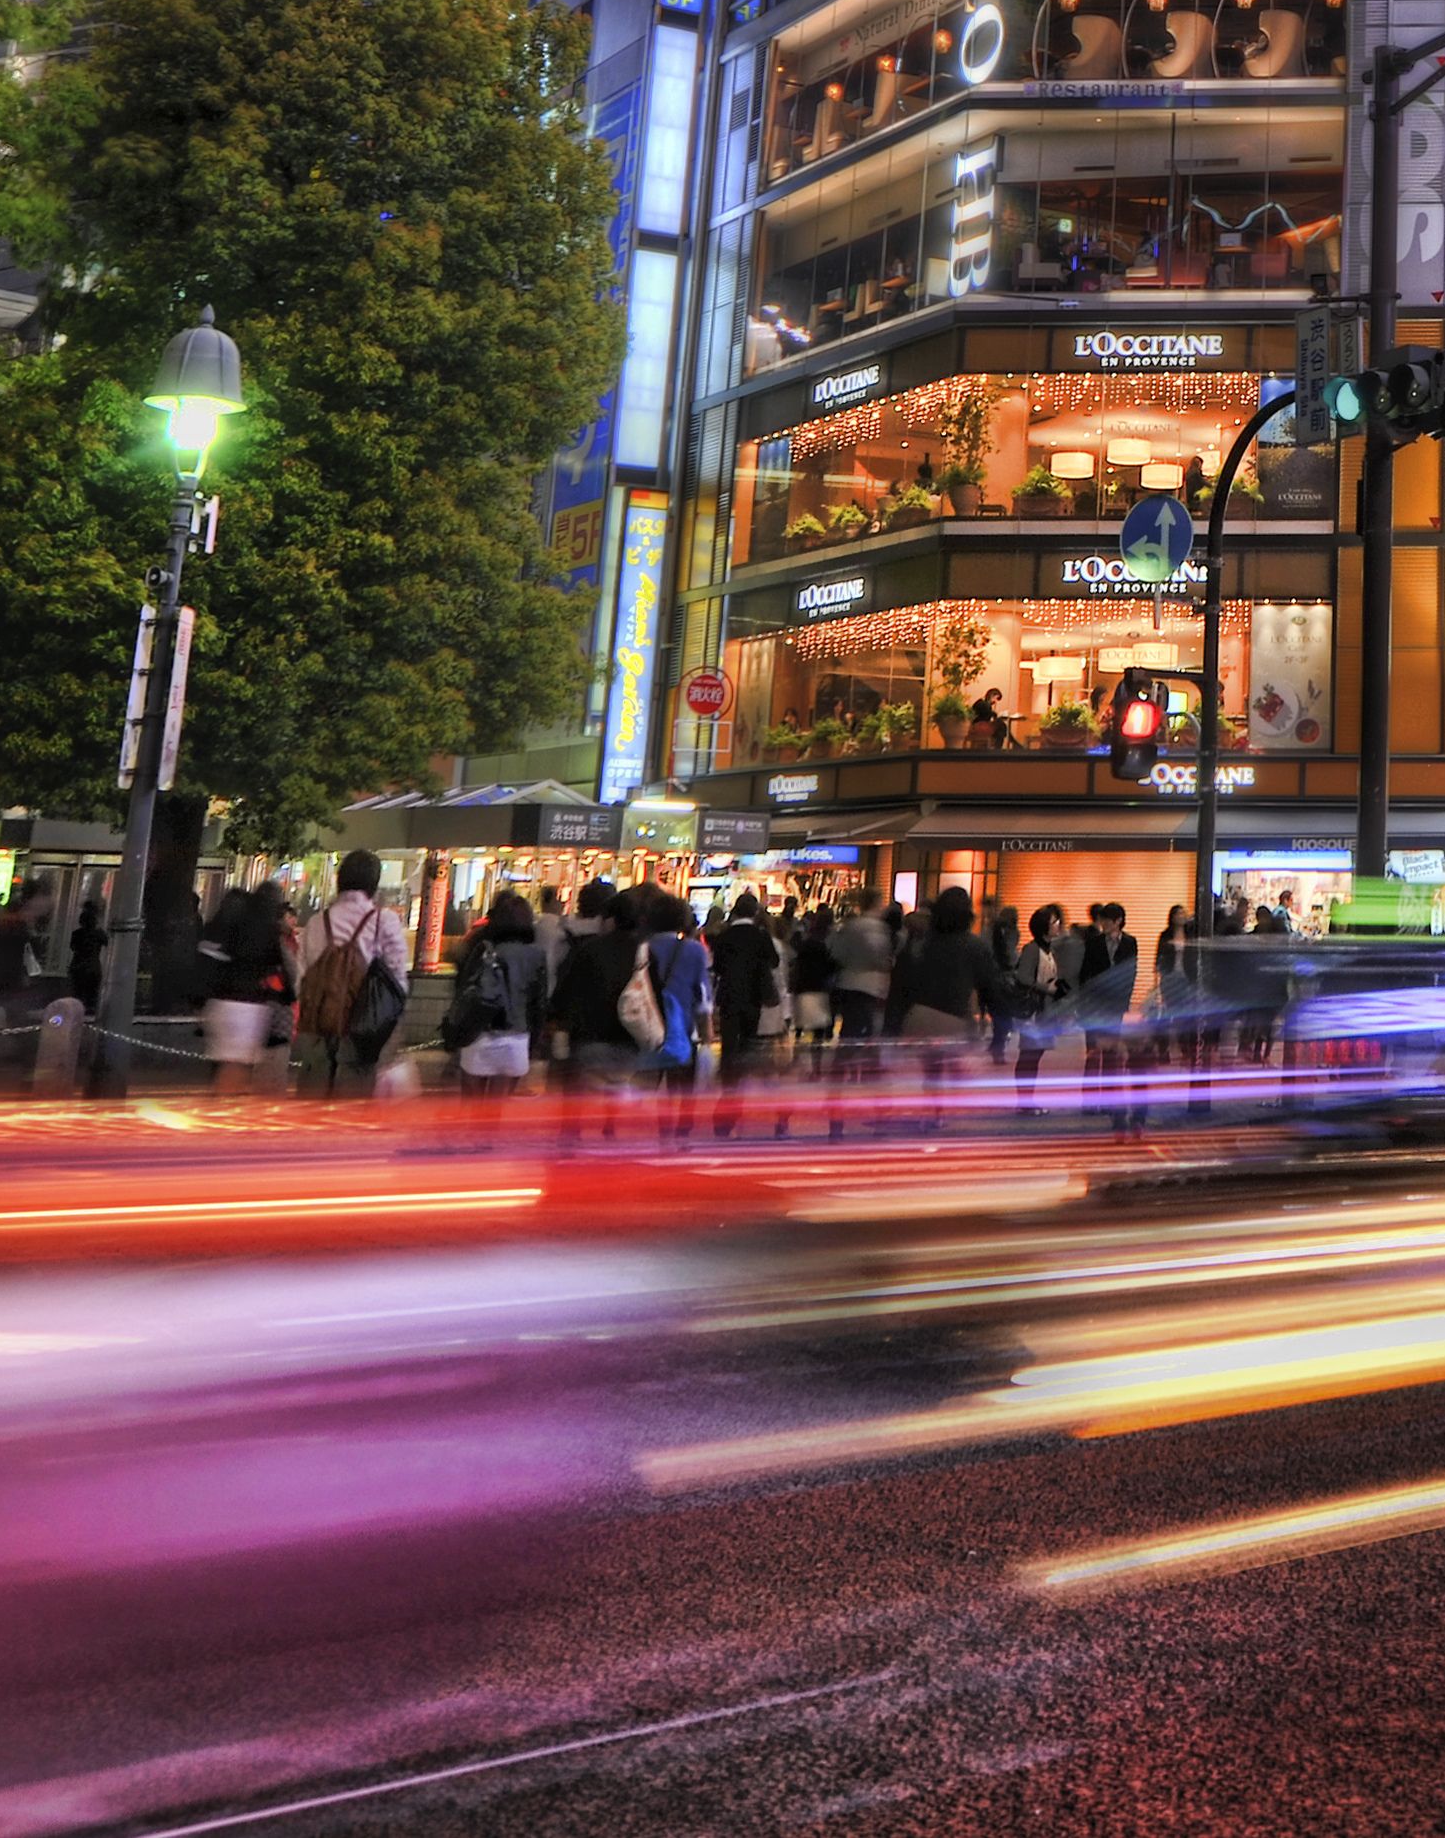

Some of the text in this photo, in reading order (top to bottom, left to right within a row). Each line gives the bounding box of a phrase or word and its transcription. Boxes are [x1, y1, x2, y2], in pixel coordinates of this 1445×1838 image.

[1038, 80, 1170, 98] Restaurant
[1074, 331, 1224, 358] L'OCCITANE
[1100, 356, 1196, 368] EN PROVENCE
[813, 364, 880, 404] L'OCCITANE
[1310, 317, 1325, 433] 渋谷駅前
[1062, 556, 1209, 583] L'OCCANE
[797, 577, 865, 611] L'OCCITANE
[1090, 583, 1107, 594] EN
[688, 685, 724, 704] 消火栓
[550, 825, 588, 842] 渋谷駅
[1001, 839, 1074, 852] L'OCCITANE
[1292, 839, 1357, 851] KIOSQUE
